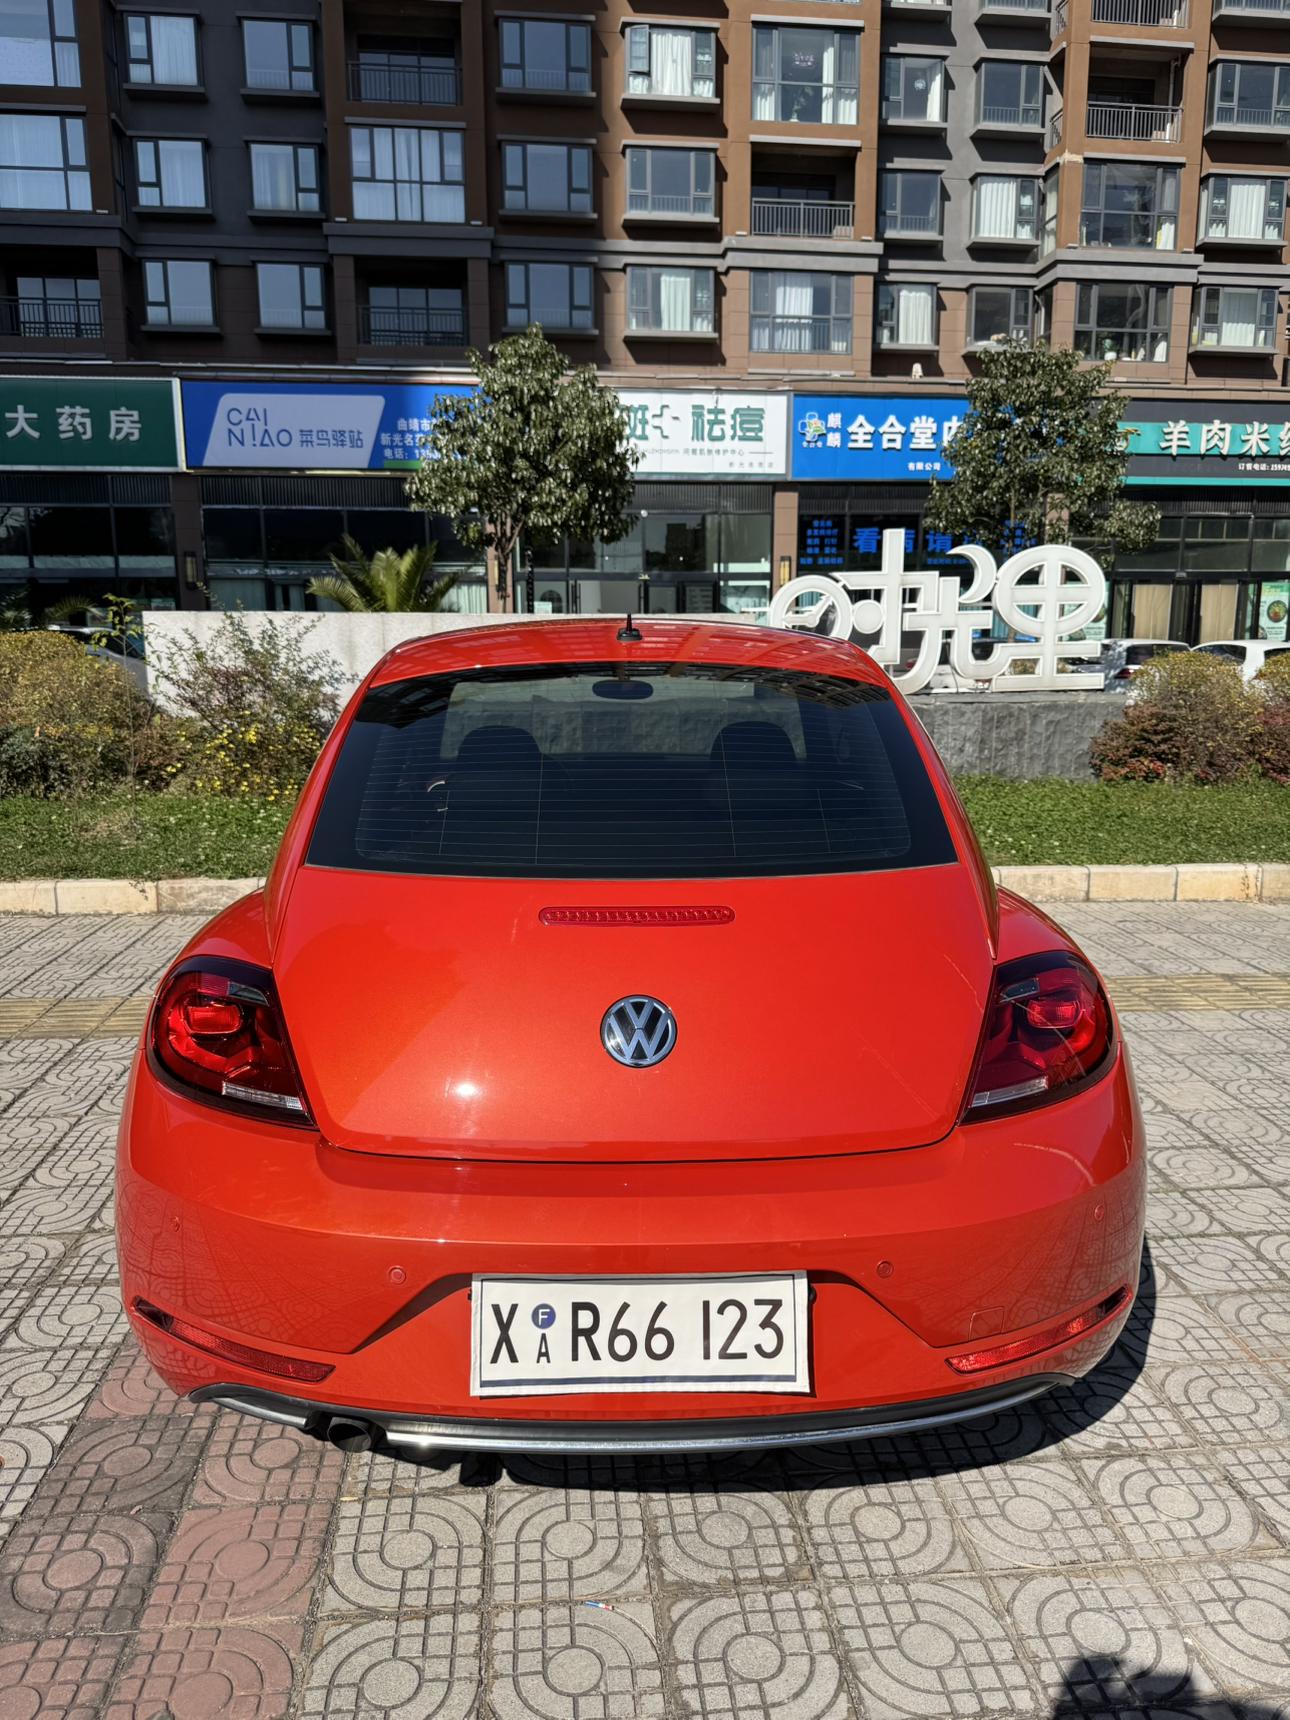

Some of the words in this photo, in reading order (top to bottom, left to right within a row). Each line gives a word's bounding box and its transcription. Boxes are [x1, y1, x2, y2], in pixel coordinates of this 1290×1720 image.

[5, 404, 142, 441] 大药房
[227, 407, 268, 426] CAI
[397, 417, 438, 432] 曲靖市
[691, 404, 765, 442] 祛痘
[299, 429, 364, 448] 菜鸟驿站
[907, 462, 942, 472] 有限公司
[490, 1303, 519, 1364] X
[571, 1301, 675, 1362] R66
[702, 1299, 784, 1360] 123
[536, 1333, 551, 1364] A
